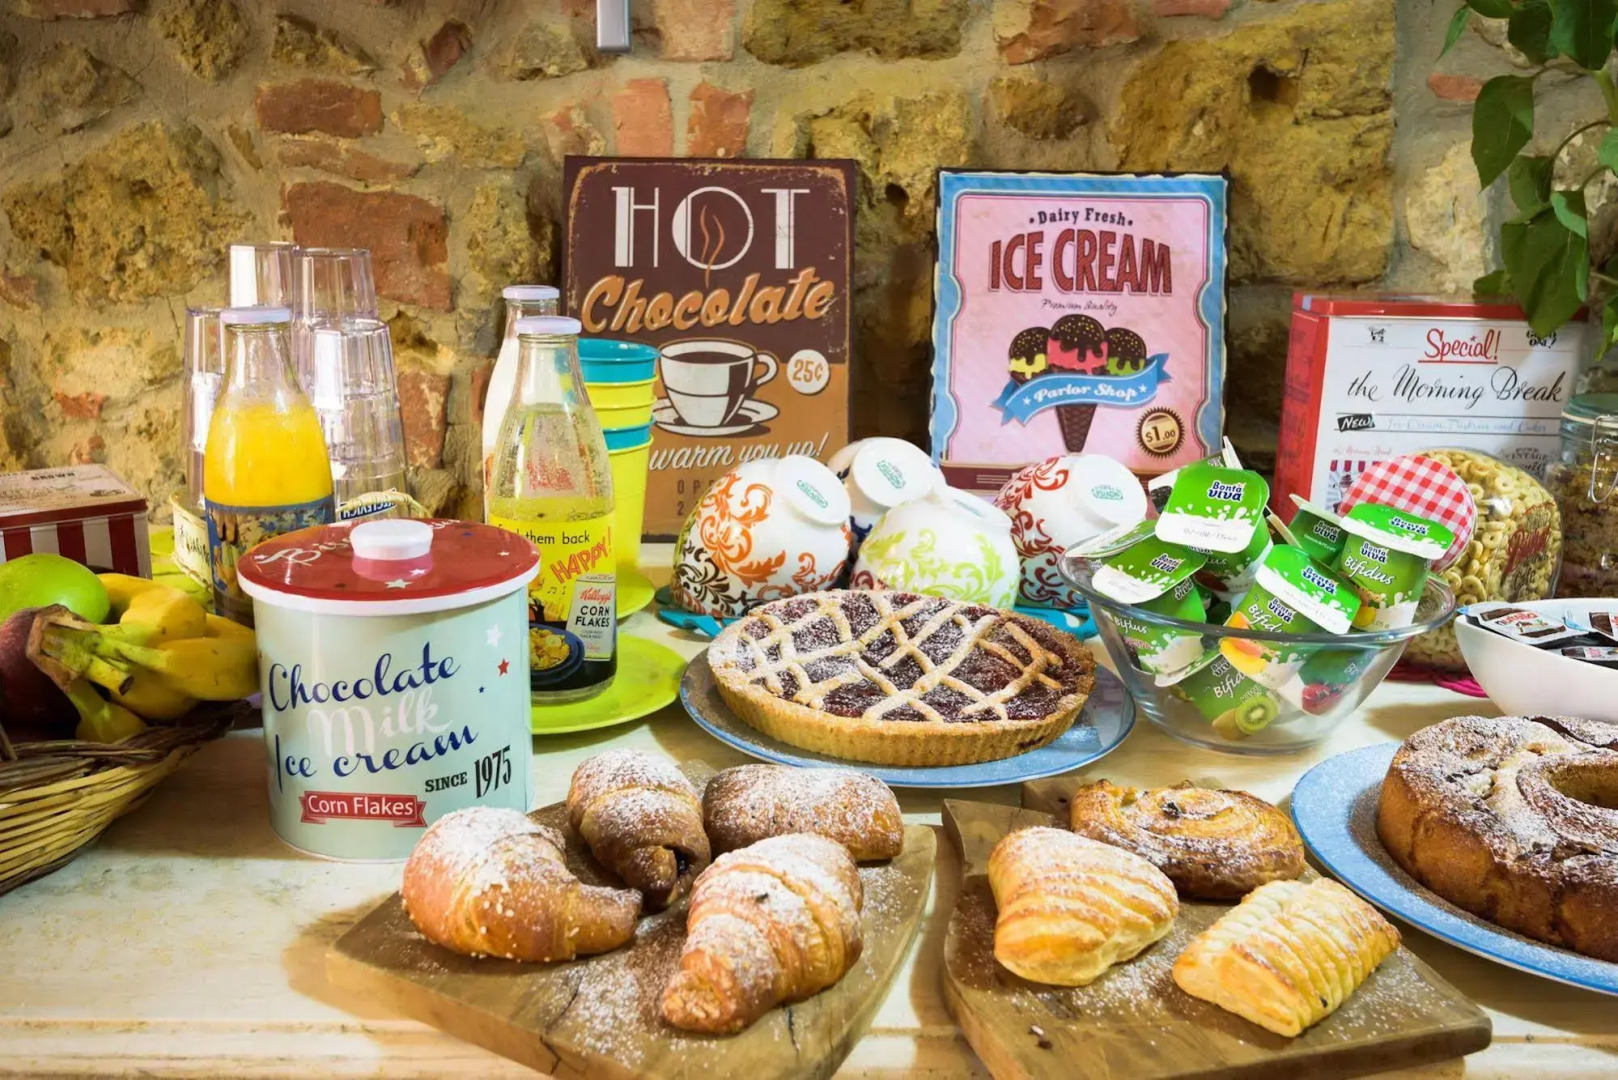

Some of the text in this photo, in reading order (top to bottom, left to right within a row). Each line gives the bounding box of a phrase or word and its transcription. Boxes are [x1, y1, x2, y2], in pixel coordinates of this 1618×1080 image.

[611, 186, 810, 270] HOT
[1038, 208, 1125, 226] Dairy Fresh
[990, 228, 1173, 294] ICE CREAM
[581, 267, 838, 334] Chocolate
[1424, 328, 1502, 361] Special!
[1034, 383, 1137, 402] Parlor Shop
[1347, 364, 1567, 410] the Morning Break
[1145, 426, 1176, 443] $1.00
[649, 444, 735, 471] warm
[525, 529, 555, 545] them
[562, 529, 590, 545] back
[549, 526, 612, 584] HAPPY!
[1344, 556, 1395, 585] Bifidus
[575, 616, 610, 627] FLAKES
[580, 605, 610, 616] CORN
[269, 642, 460, 712] Chocolate
[307, 686, 453, 758] Milk
[274, 724, 479, 794] Ice cream
[424, 745, 512, 798] SINCE 1975
[308, 794, 414, 816] Corn Flakes
